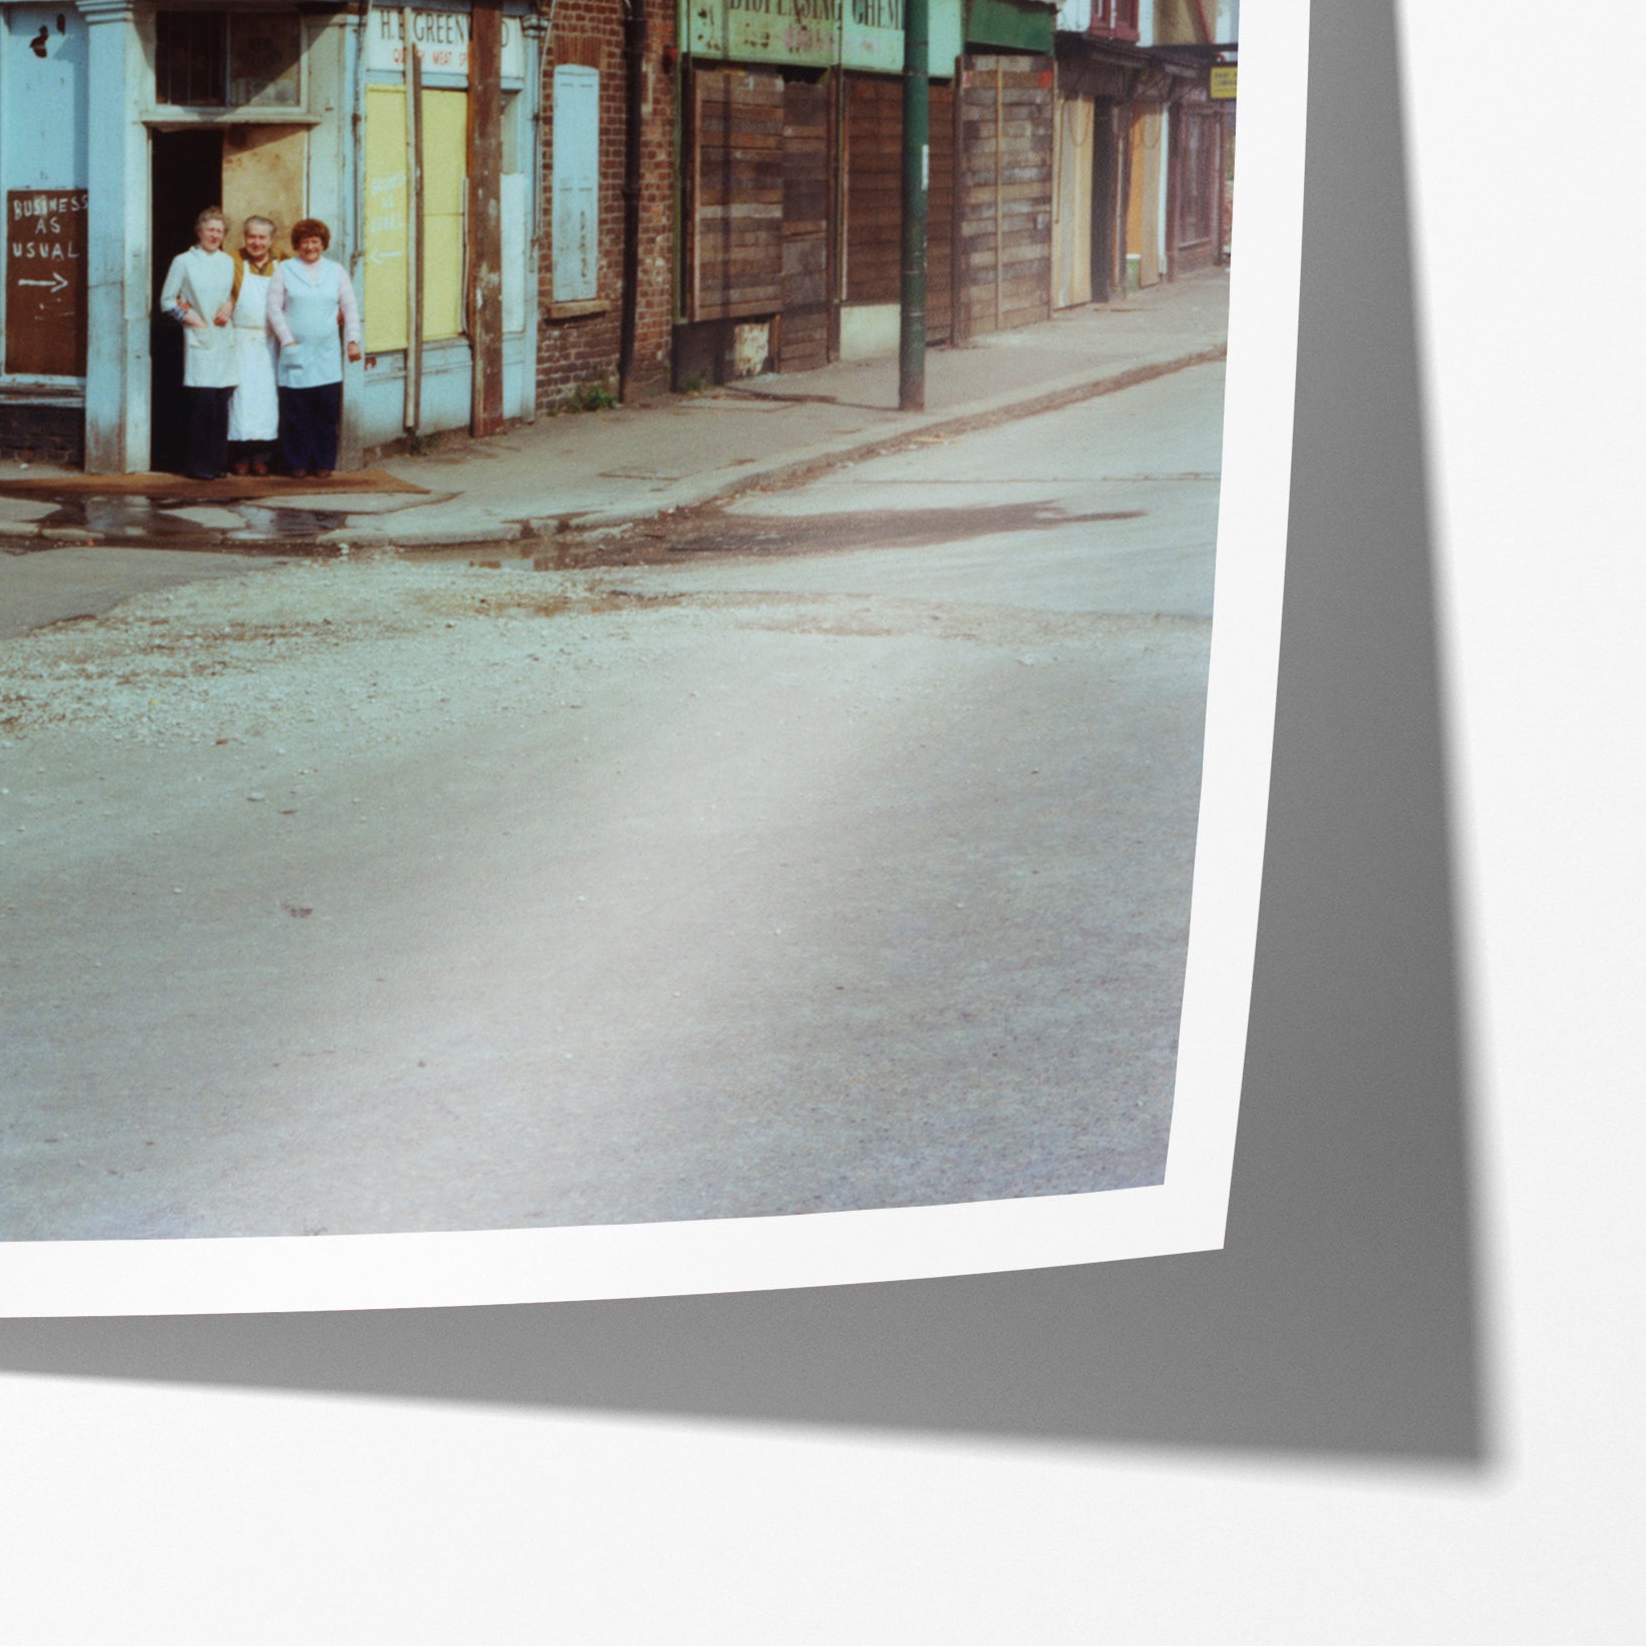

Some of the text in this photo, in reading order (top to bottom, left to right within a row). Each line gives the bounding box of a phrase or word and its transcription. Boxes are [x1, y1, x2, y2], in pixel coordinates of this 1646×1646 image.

[14, 194, 90, 221] BUSINESS
[35, 217, 61, 235] AS
[13, 241, 80, 261] USUAL
